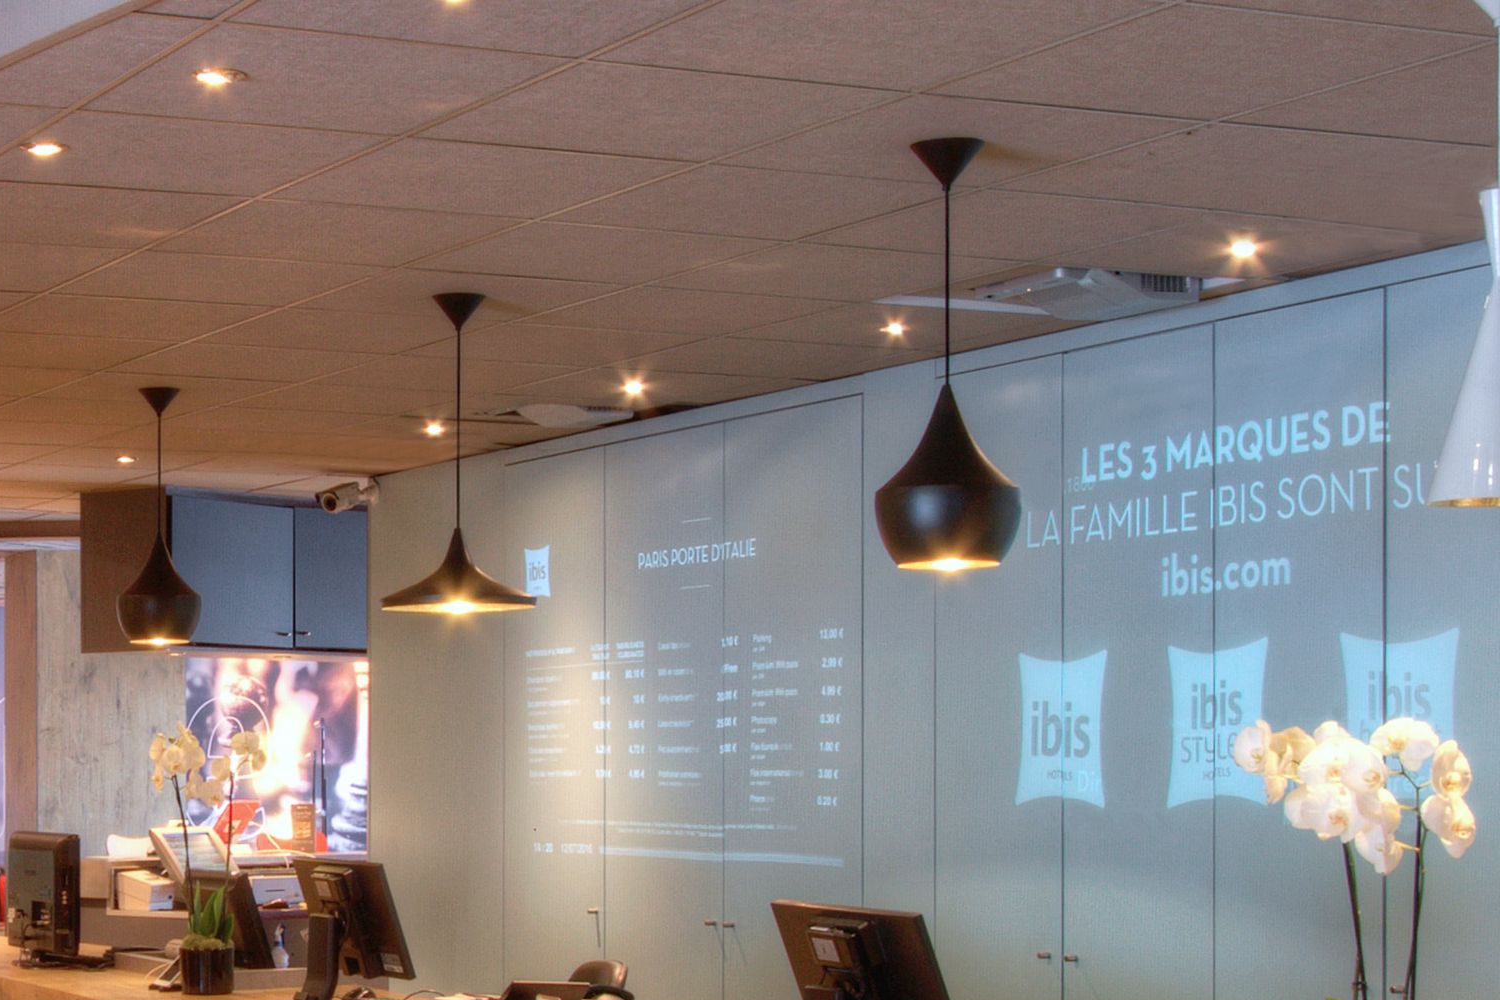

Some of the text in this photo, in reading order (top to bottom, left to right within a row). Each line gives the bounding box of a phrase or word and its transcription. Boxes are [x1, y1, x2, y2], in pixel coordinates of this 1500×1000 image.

[1080, 402, 1391, 484] LES 3 MARQUES DE
[1026, 510, 1061, 549] LA
[1070, 490, 1198, 545] FAMILLE
[1209, 481, 1265, 528] IBIS
[1277, 466, 1378, 519] SONT
[528, 562, 546, 582] ibis
[638, 537, 757, 570] PARIS PORTE D'ITALIE
[1161, 552, 1291, 597] ibis.com
[1031, 700, 1090, 758] ibis
[1191, 680, 1242, 730] ibis
